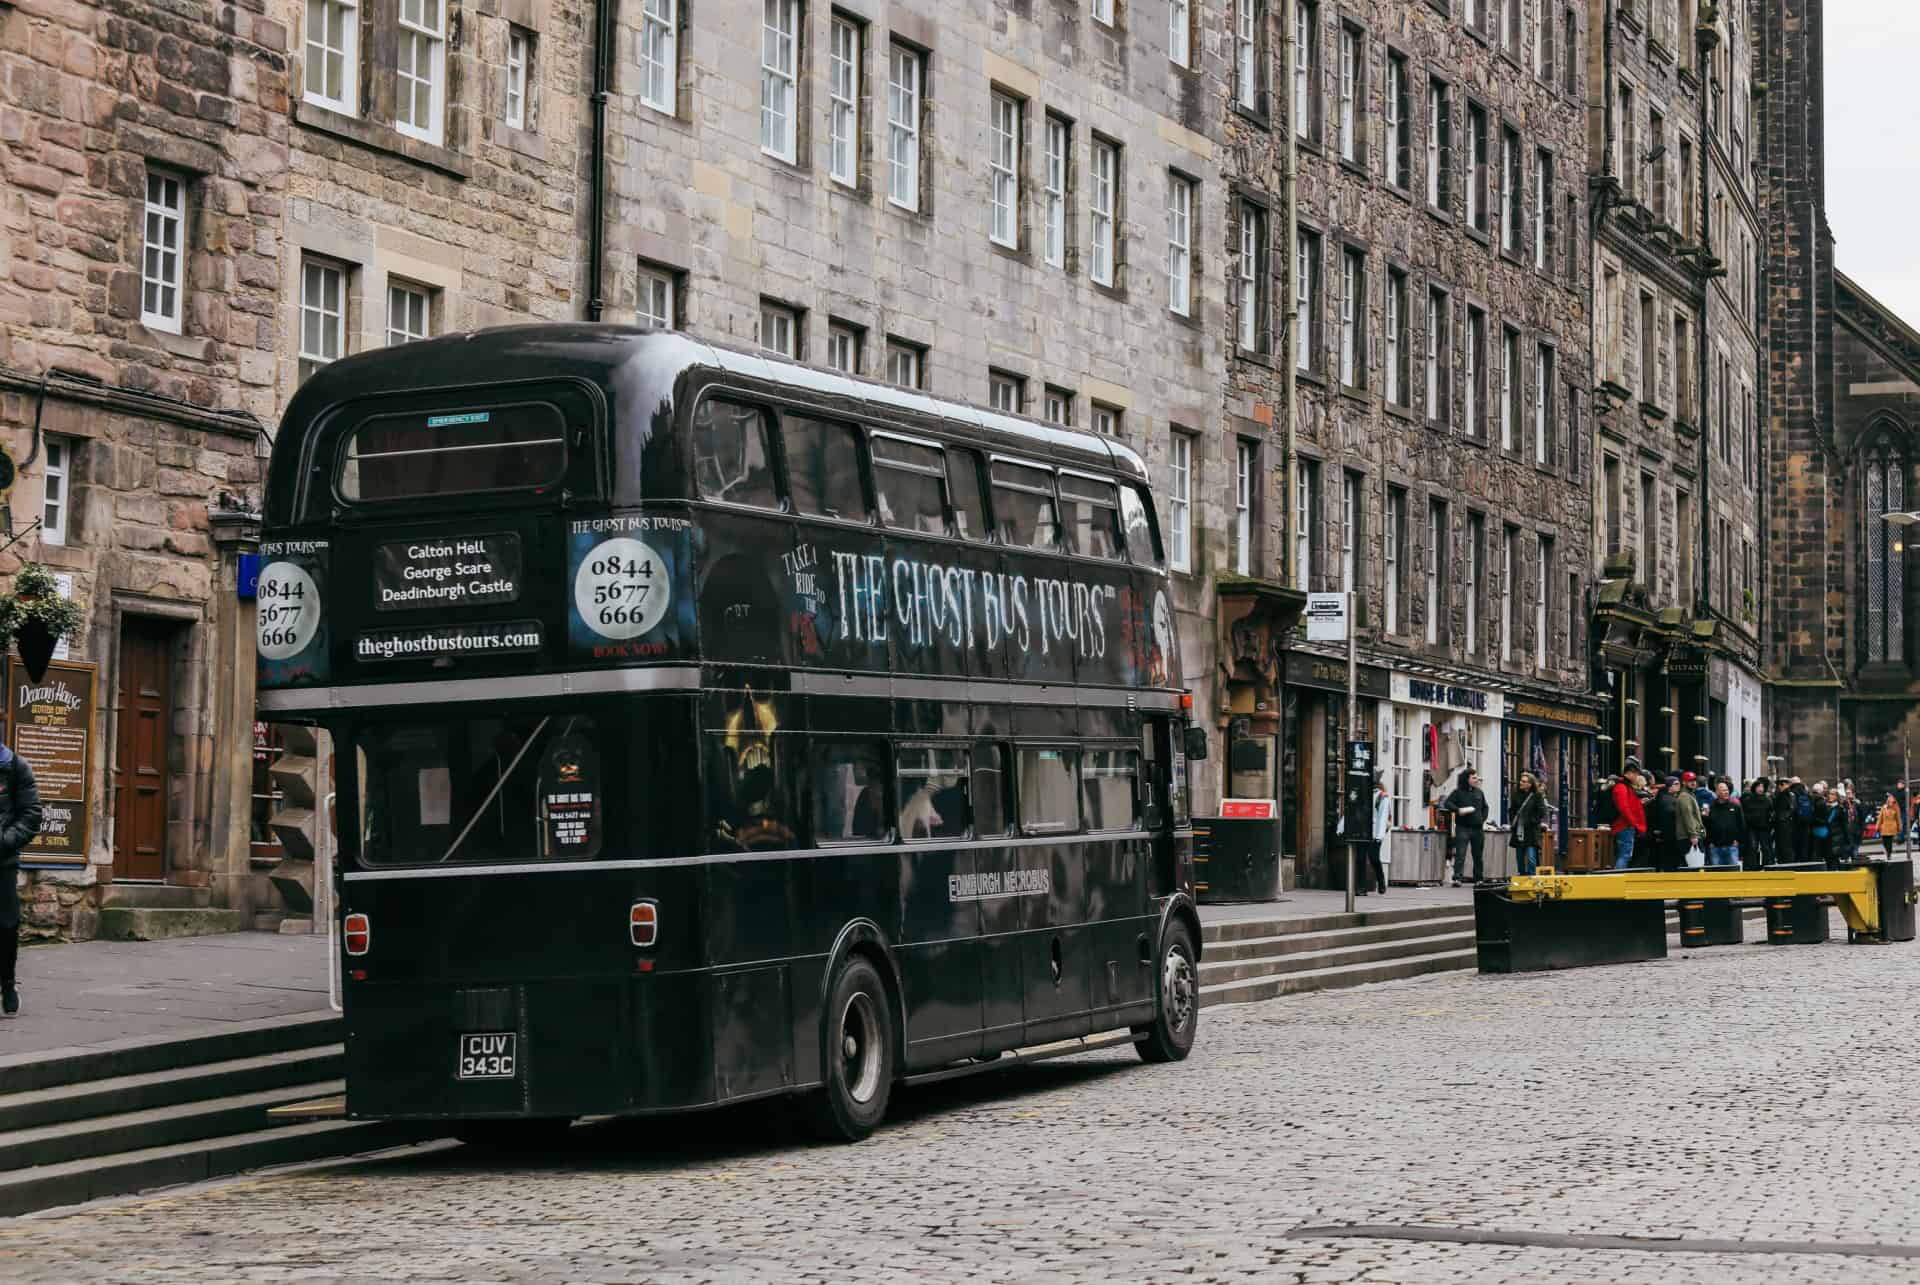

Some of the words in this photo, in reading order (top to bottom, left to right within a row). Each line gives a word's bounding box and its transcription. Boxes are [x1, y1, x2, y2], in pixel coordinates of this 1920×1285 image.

[573, 519, 590, 534] THE
[592, 518, 626, 533] GHOST
[628, 517, 650, 530] BUS
[408, 544, 453, 559] Calton
[456, 540, 486, 555] Hell
[781, 543, 810, 576] TAKE
[404, 565, 451, 581] George
[455, 562, 492, 576] Scare
[592, 555, 653, 579] 0844
[259, 579, 305, 601] 0844
[382, 583, 466, 602] Deadinburgh
[469, 579, 513, 595] Castle
[594, 580, 650, 604] 5677
[795, 573, 816, 594] RIDE
[832, 550, 887, 642] THE
[892, 559, 976, 648] GHOST
[982, 570, 1030, 653] BUS
[259, 603, 302, 626] 5677
[600, 605, 644, 625] 666
[262, 627, 297, 646] 666
[358, 632, 540, 658] theghostbustours.com
[948, 871, 1001, 902] EDINBURGH
[1003, 868, 1049, 894] NECROBUS
[470, 1036, 507, 1054] CUV
[464, 1056, 513, 1075] 343C
